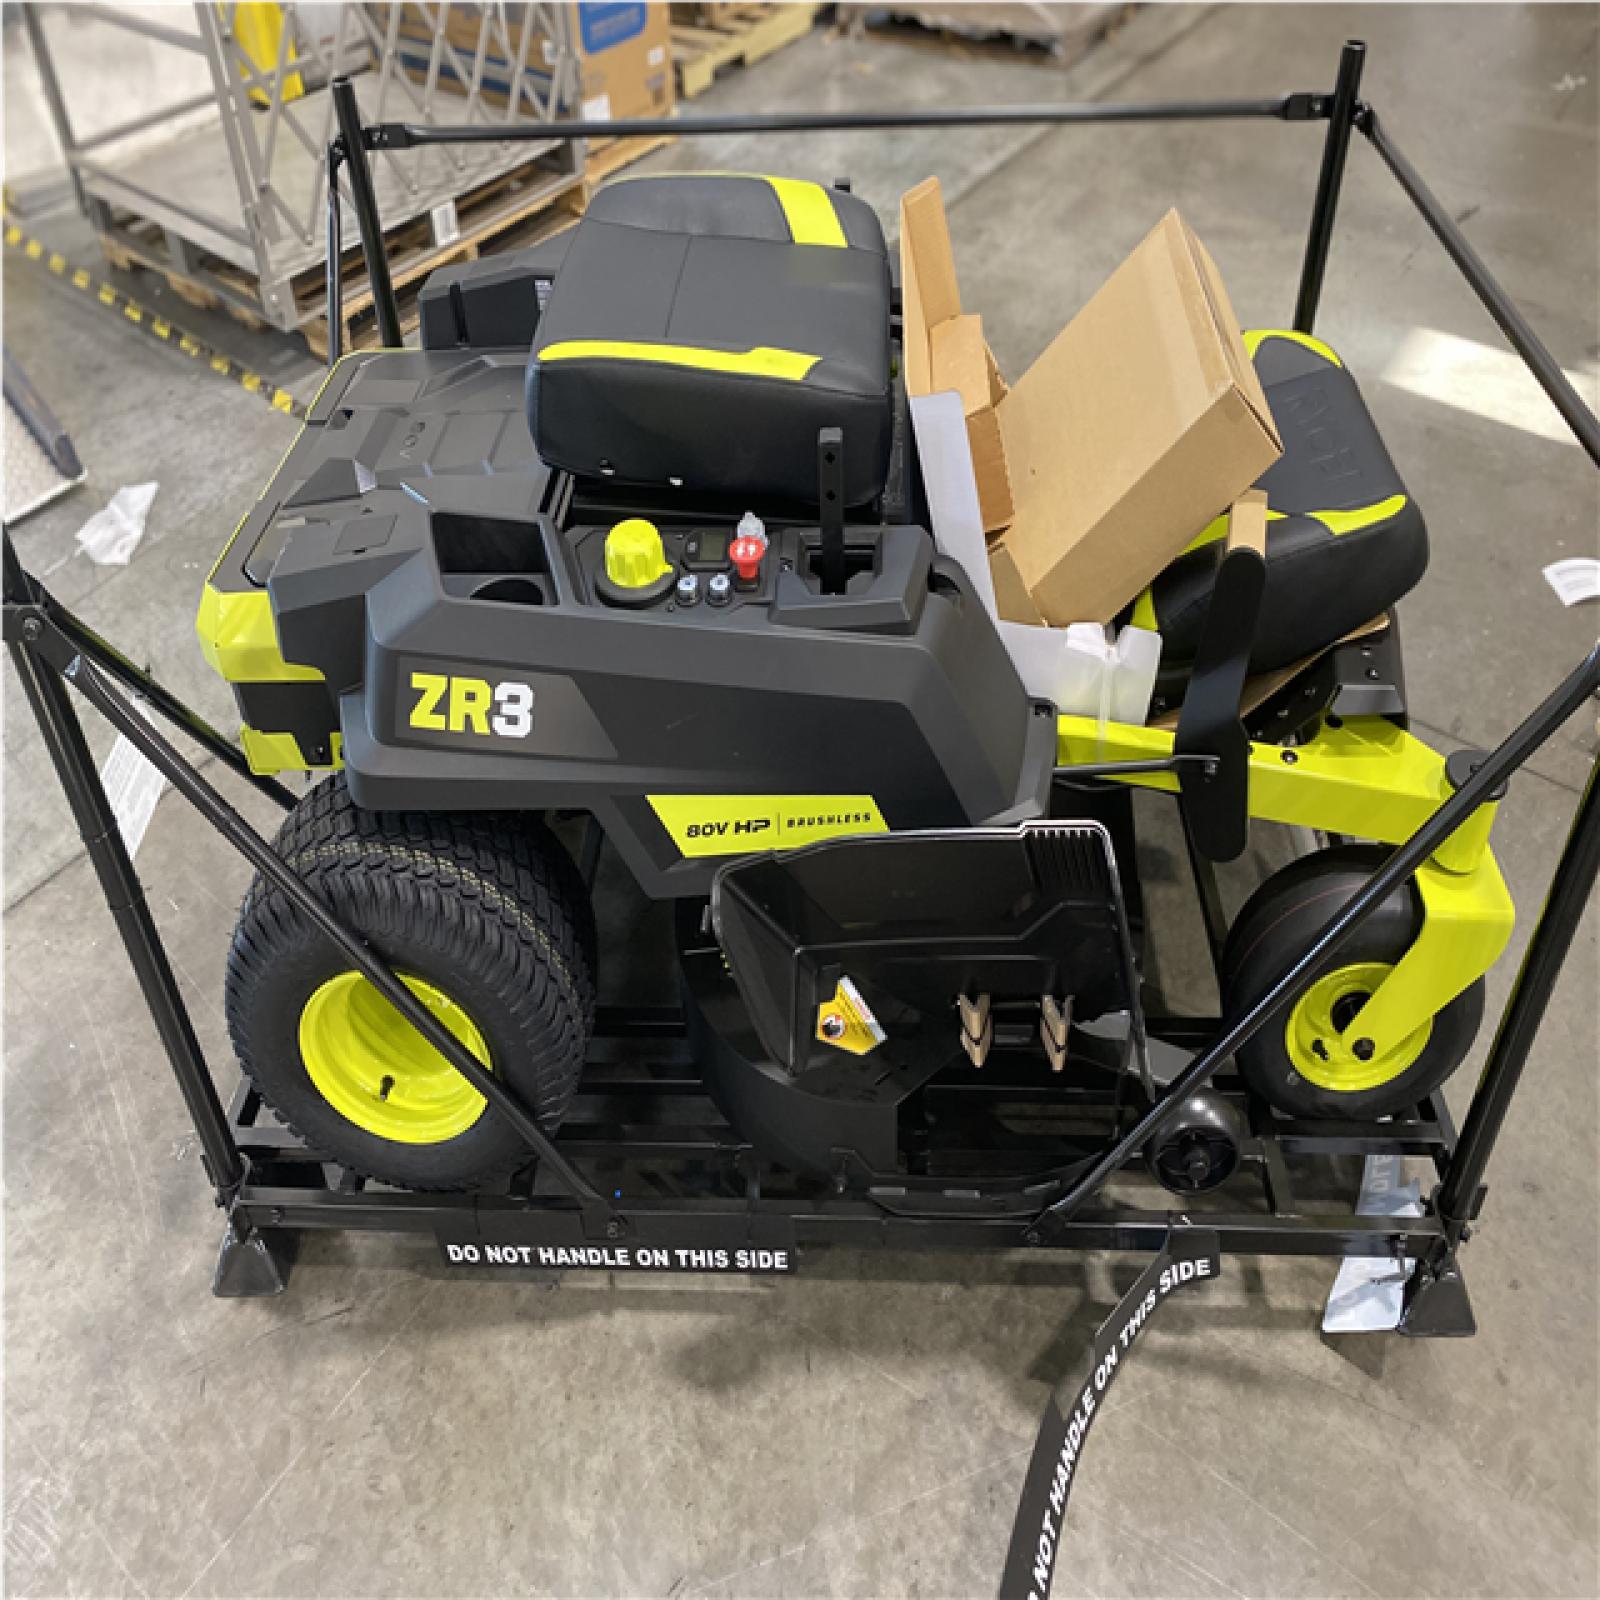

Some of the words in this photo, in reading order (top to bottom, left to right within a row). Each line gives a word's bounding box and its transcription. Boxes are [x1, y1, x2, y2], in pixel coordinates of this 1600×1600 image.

[410, 672, 534, 738] ZR3
[686, 822, 729, 838] 80V
[735, 819, 771, 835] HP
[787, 812, 871, 828] BRUSHLESS
[447, 1244, 480, 1263] DO
[485, 1244, 531, 1264] NOT
[538, 1246, 631, 1266] HANDLE
[636, 1249, 671, 1267] ON
[675, 1249, 729, 1269] THIS
[735, 1250, 789, 1269] SIDE
[1033, 1509, 1056, 1592] NOT
[1049, 1387, 1096, 1515] HANDLE
[1094, 1345, 1118, 1391] ON
[1120, 1289, 1157, 1347] THIS
[1159, 1258, 1211, 1294] SIDE
